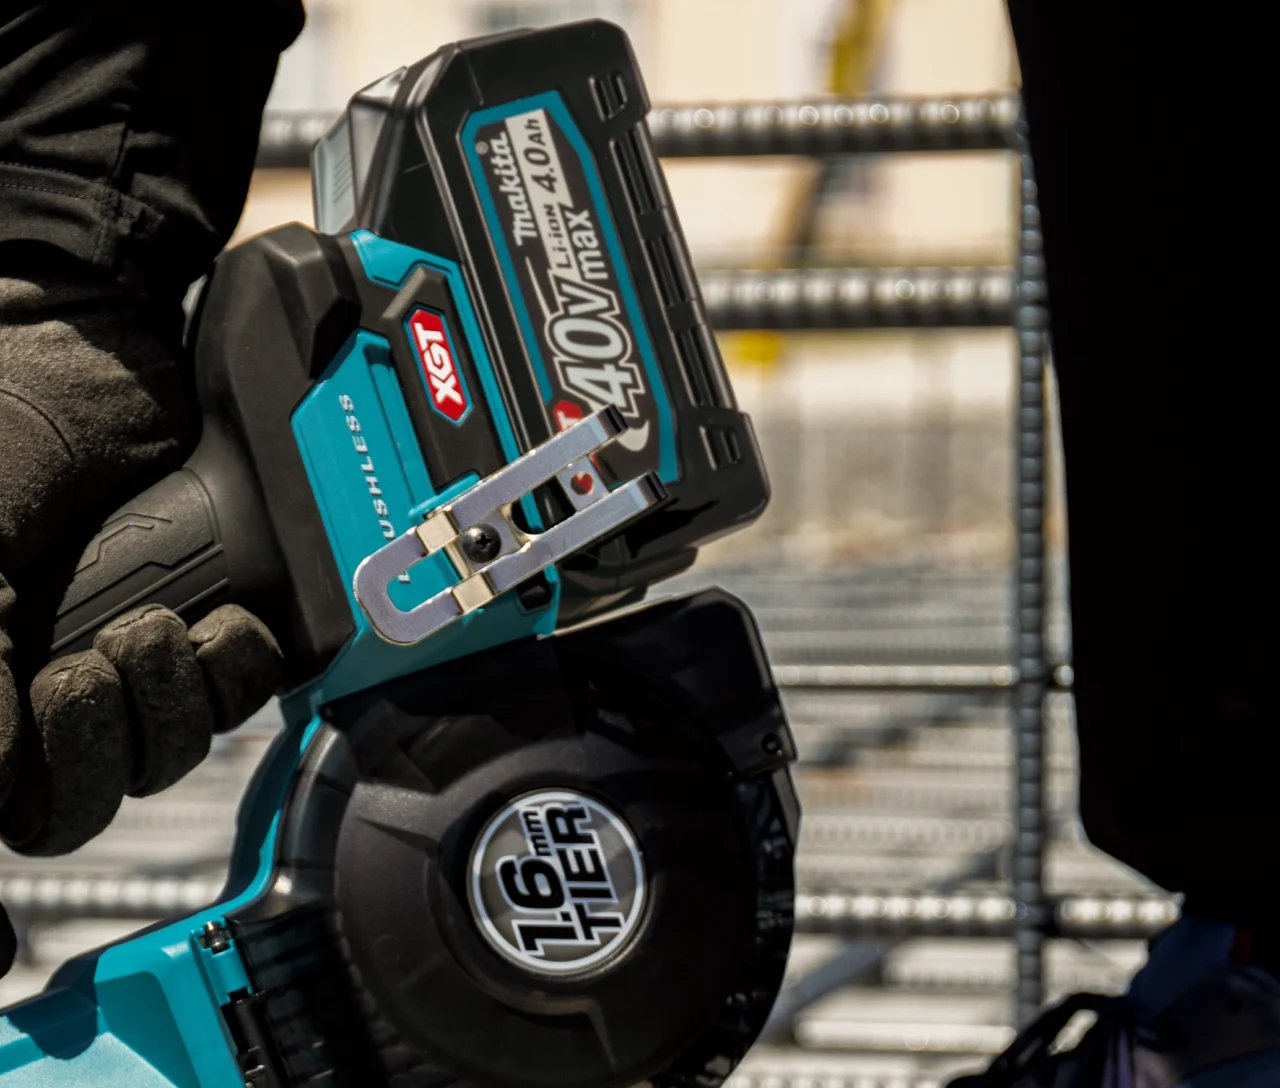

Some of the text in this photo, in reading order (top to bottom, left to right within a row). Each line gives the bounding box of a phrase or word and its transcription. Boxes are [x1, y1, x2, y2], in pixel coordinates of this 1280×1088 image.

[490, 130, 538, 246] makita
[520, 118, 558, 201] 4.0Ah
[566, 210, 610, 281] max
[418, 322, 462, 405] XGT
[549, 271, 641, 413] 40V
[339, 394, 411, 583] USHLESS
[545, 806, 624, 941] TIER
